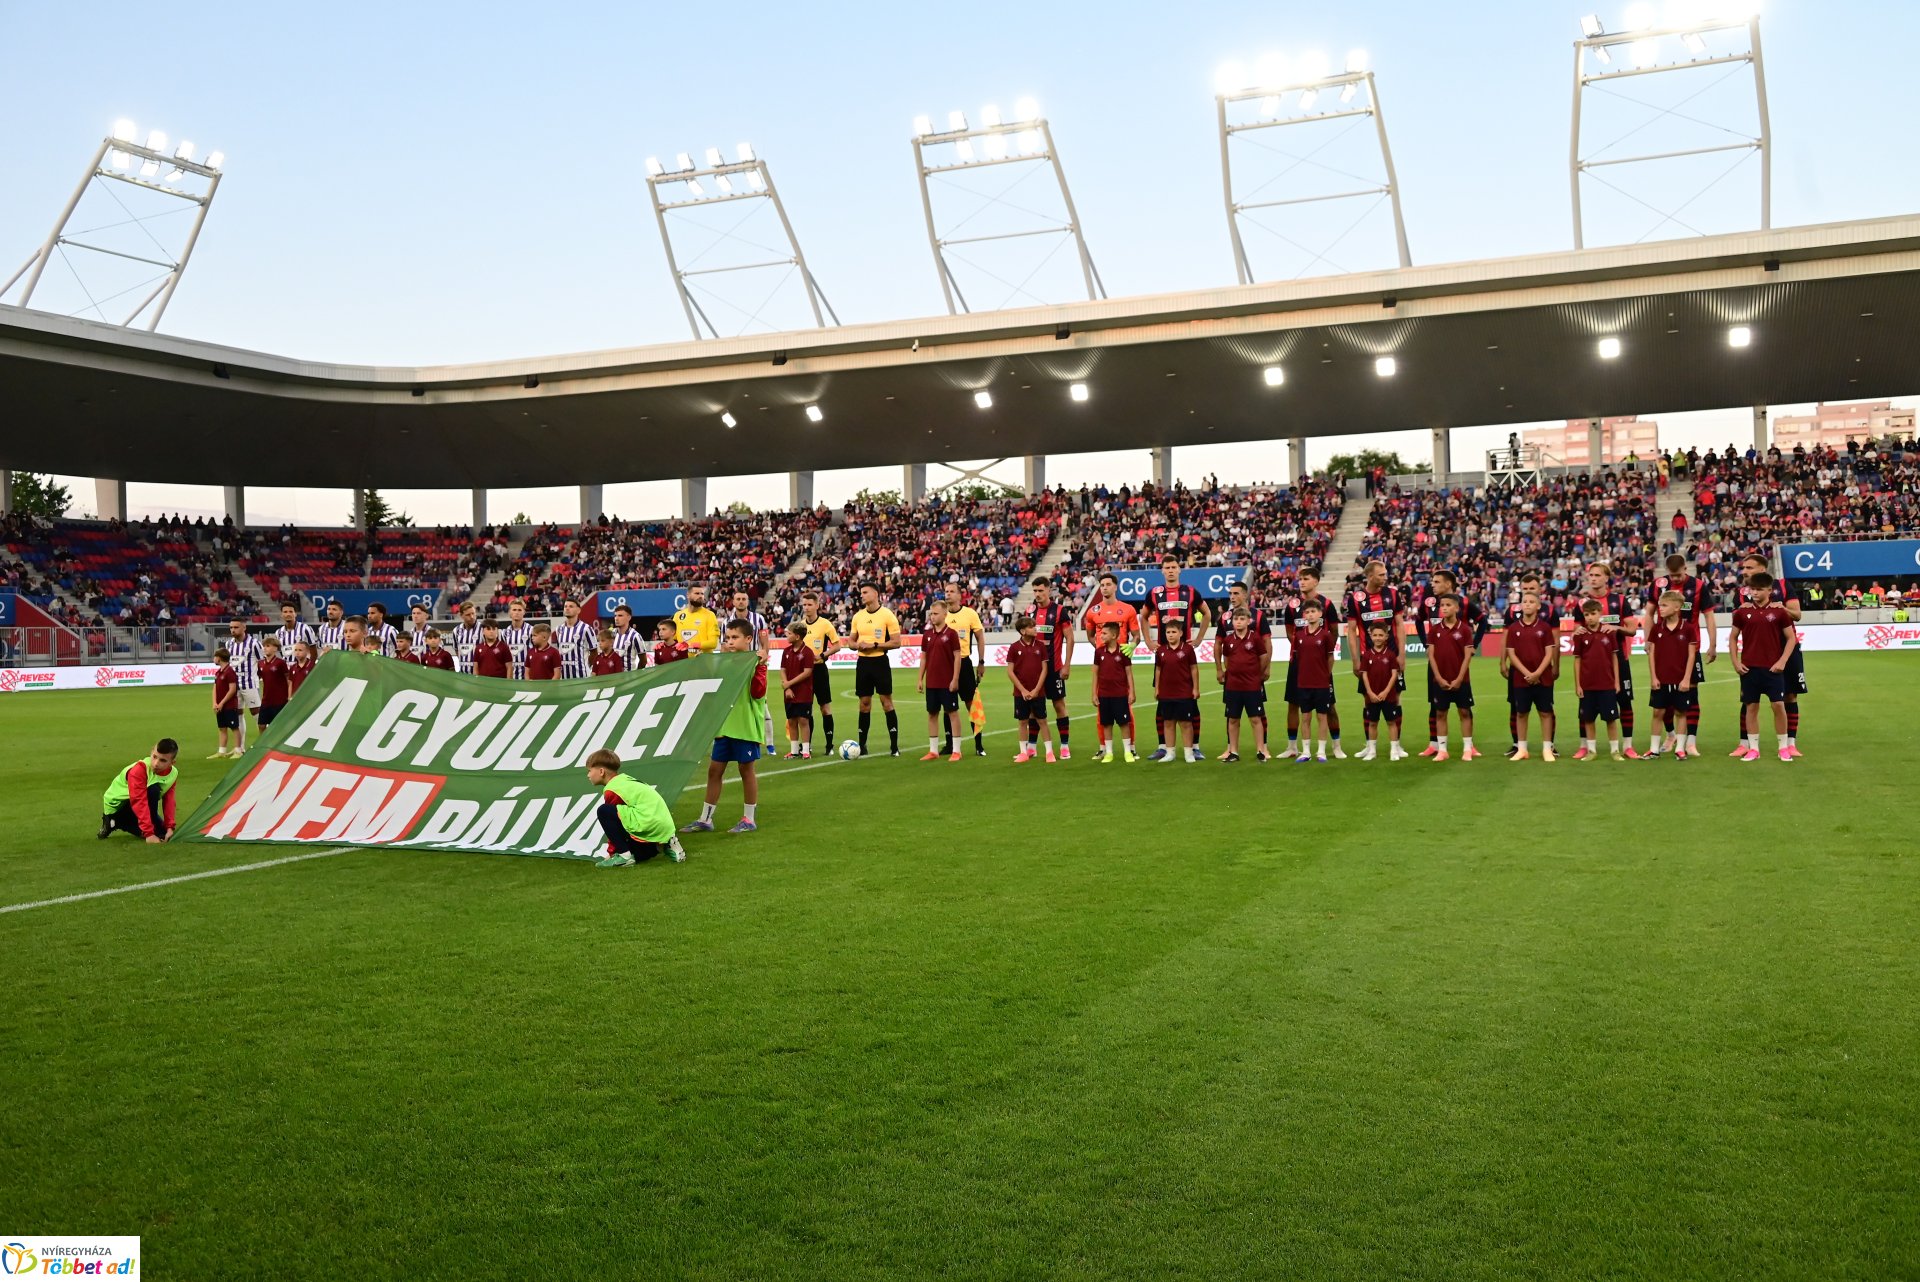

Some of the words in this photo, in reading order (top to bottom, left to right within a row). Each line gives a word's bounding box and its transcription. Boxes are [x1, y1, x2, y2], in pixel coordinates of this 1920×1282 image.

[1794, 550, 1834, 572] C4
[1119, 577, 1147, 596] C6
[406, 594, 433, 611] C8
[20, 673, 56, 682] REVESZ
[284, 677, 368, 754] A
[355, 678, 724, 771] GYŰLÖLET
